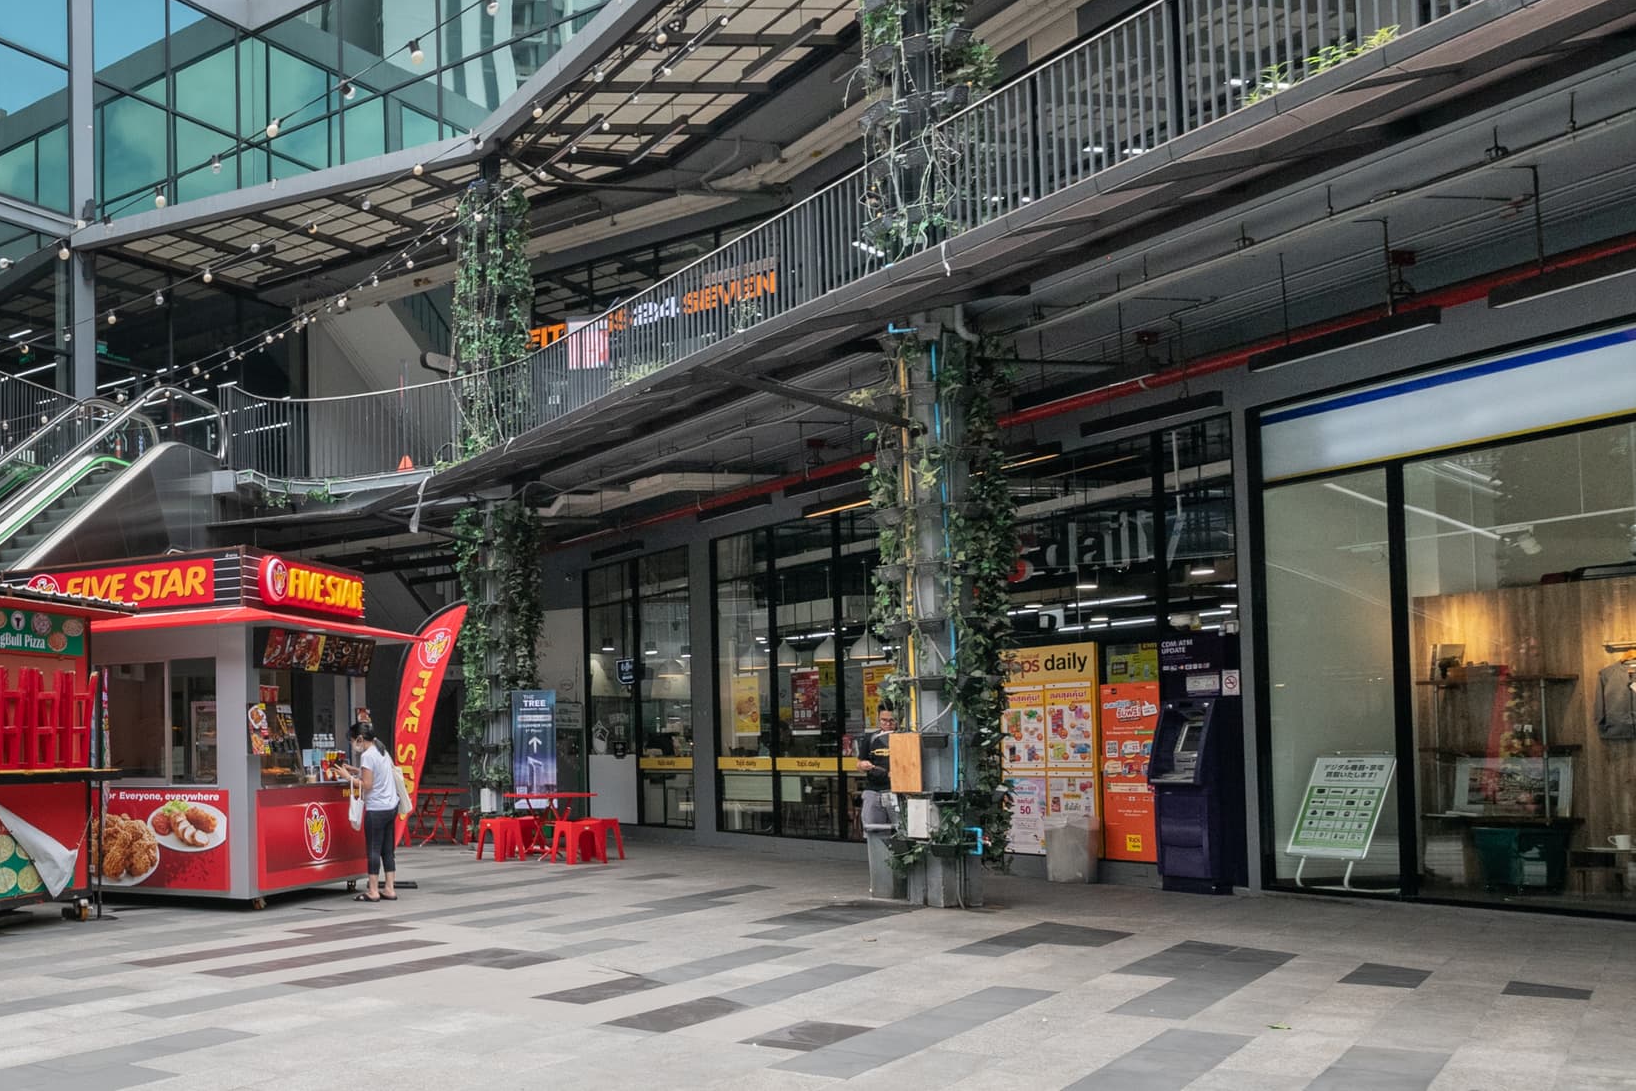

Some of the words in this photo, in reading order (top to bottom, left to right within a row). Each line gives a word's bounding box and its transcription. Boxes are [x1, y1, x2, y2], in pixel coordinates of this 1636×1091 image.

[683, 271, 776, 315] SEVEN
[66, 573, 127, 602] FIVE
[132, 565, 208, 601] STAR
[288, 568, 325, 603] FIVE
[325, 575, 363, 611] STAR
[24, 634, 46, 649] Pizza
[1044, 652, 1087, 672] daily
[402, 670, 433, 734] FIVE
[119, 792, 163, 801] Everyone,
[165, 792, 220, 801] everywhere
[1019, 805, 1031, 814] 50
